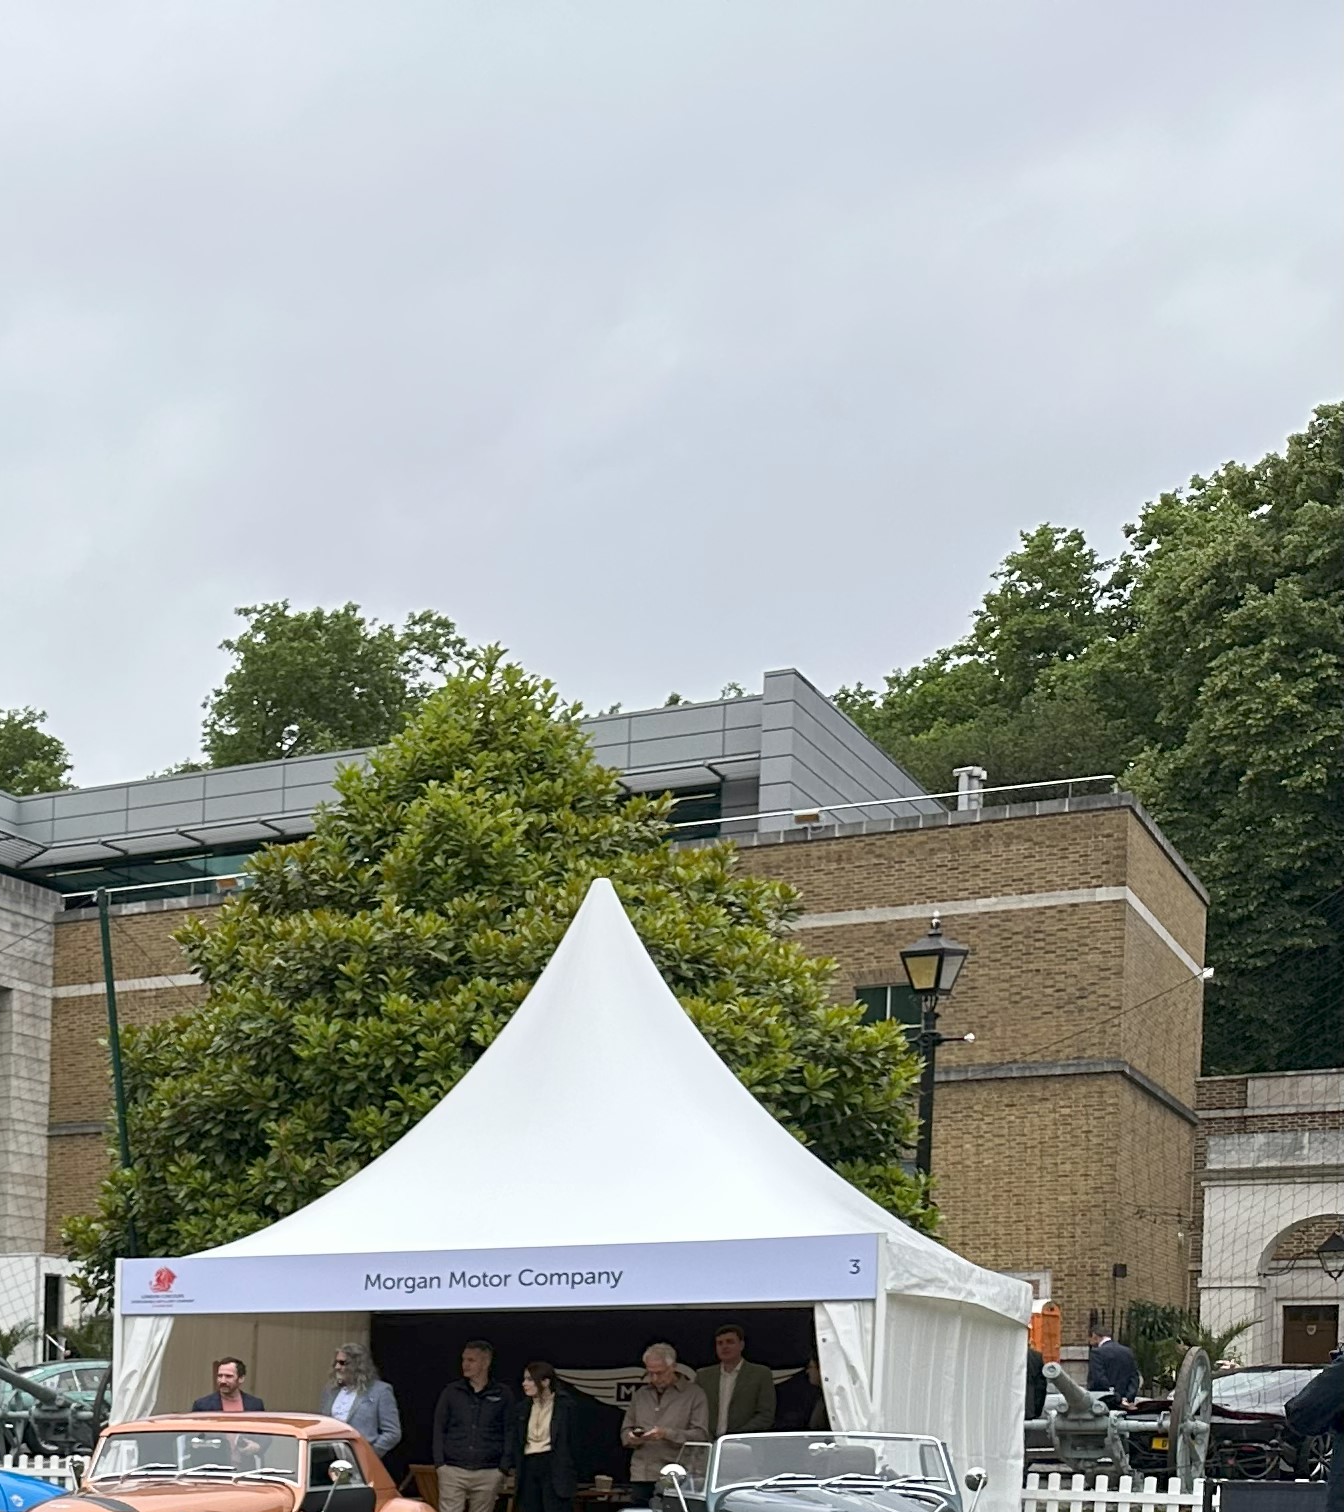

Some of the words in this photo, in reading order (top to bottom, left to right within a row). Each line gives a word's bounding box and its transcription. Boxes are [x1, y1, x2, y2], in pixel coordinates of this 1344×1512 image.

[849, 1259, 861, 1275] 3
[364, 1273, 441, 1294] Morgan
[448, 1270, 512, 1289] Motor
[517, 1268, 624, 1289] Company
